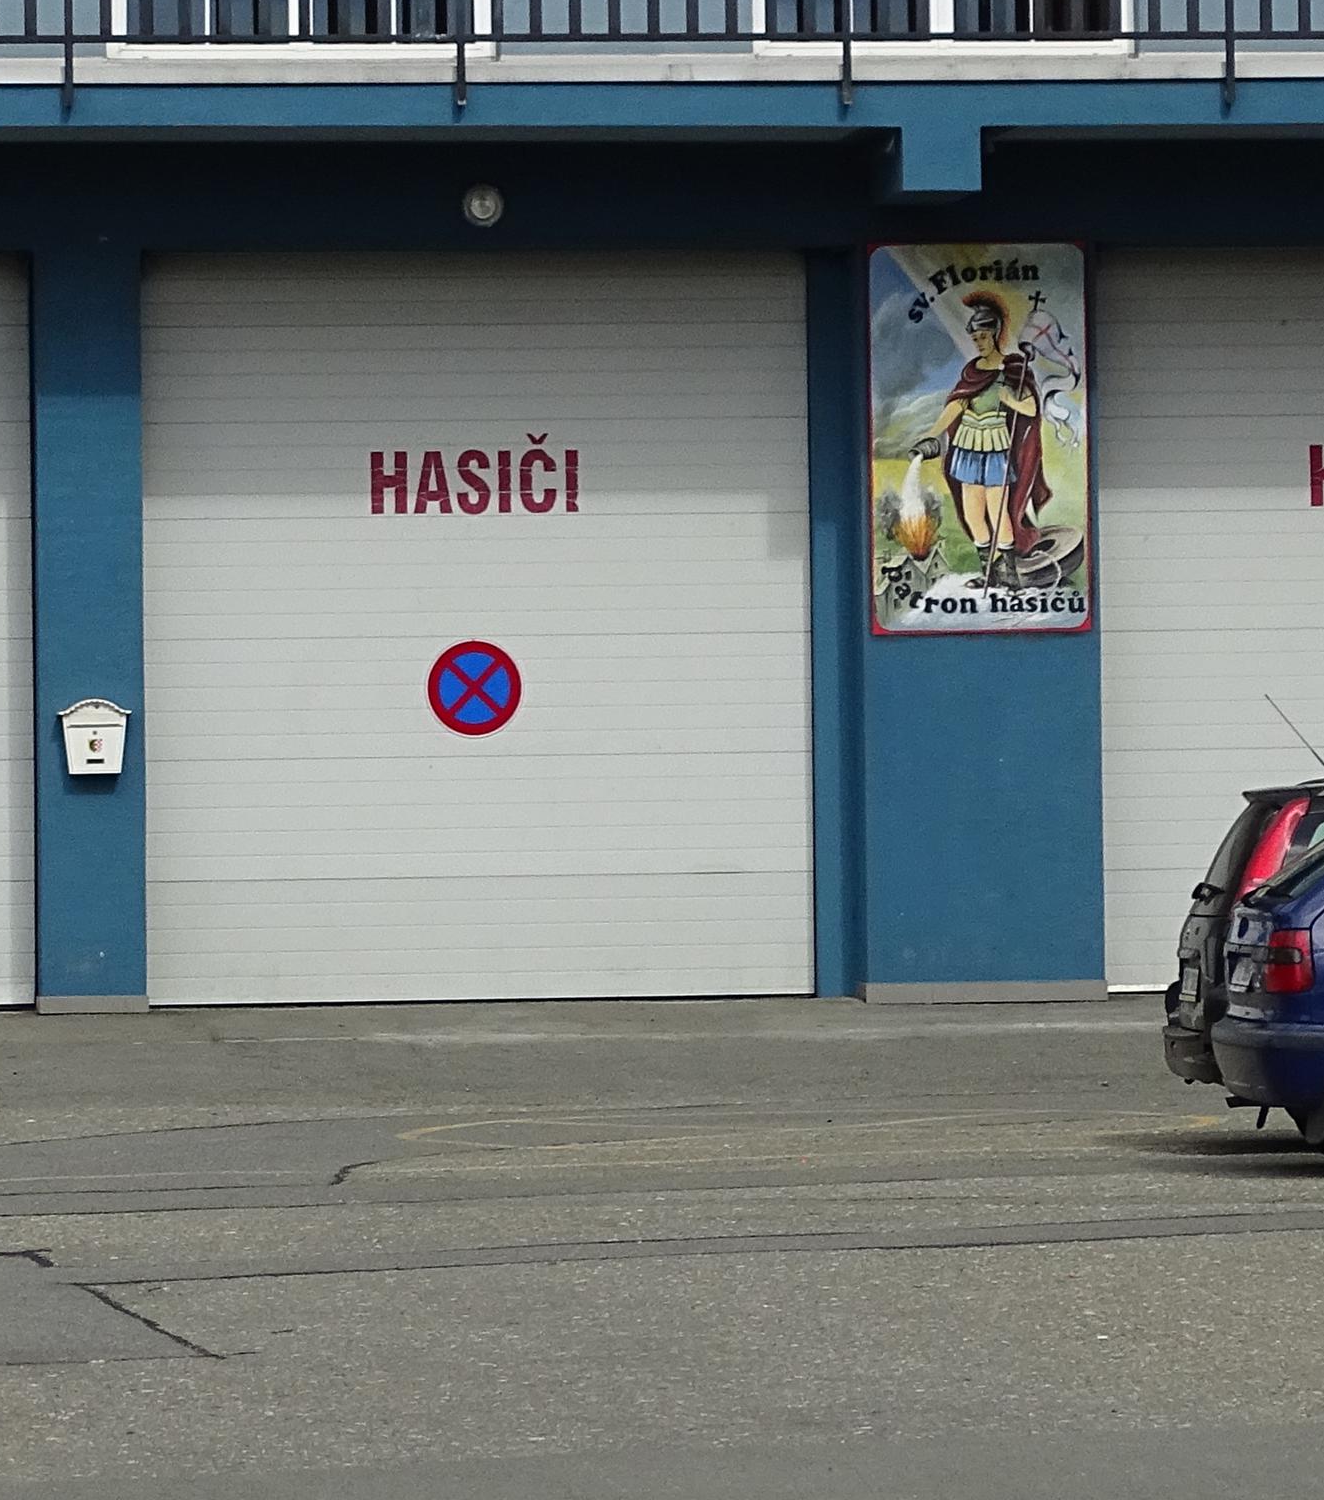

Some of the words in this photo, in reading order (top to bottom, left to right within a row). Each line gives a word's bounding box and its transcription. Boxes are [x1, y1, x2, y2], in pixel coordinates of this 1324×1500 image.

[928, 258, 1040, 296] Florián
[370, 432, 579, 515] HASIČI
[989, 590, 1087, 613] hasičů
